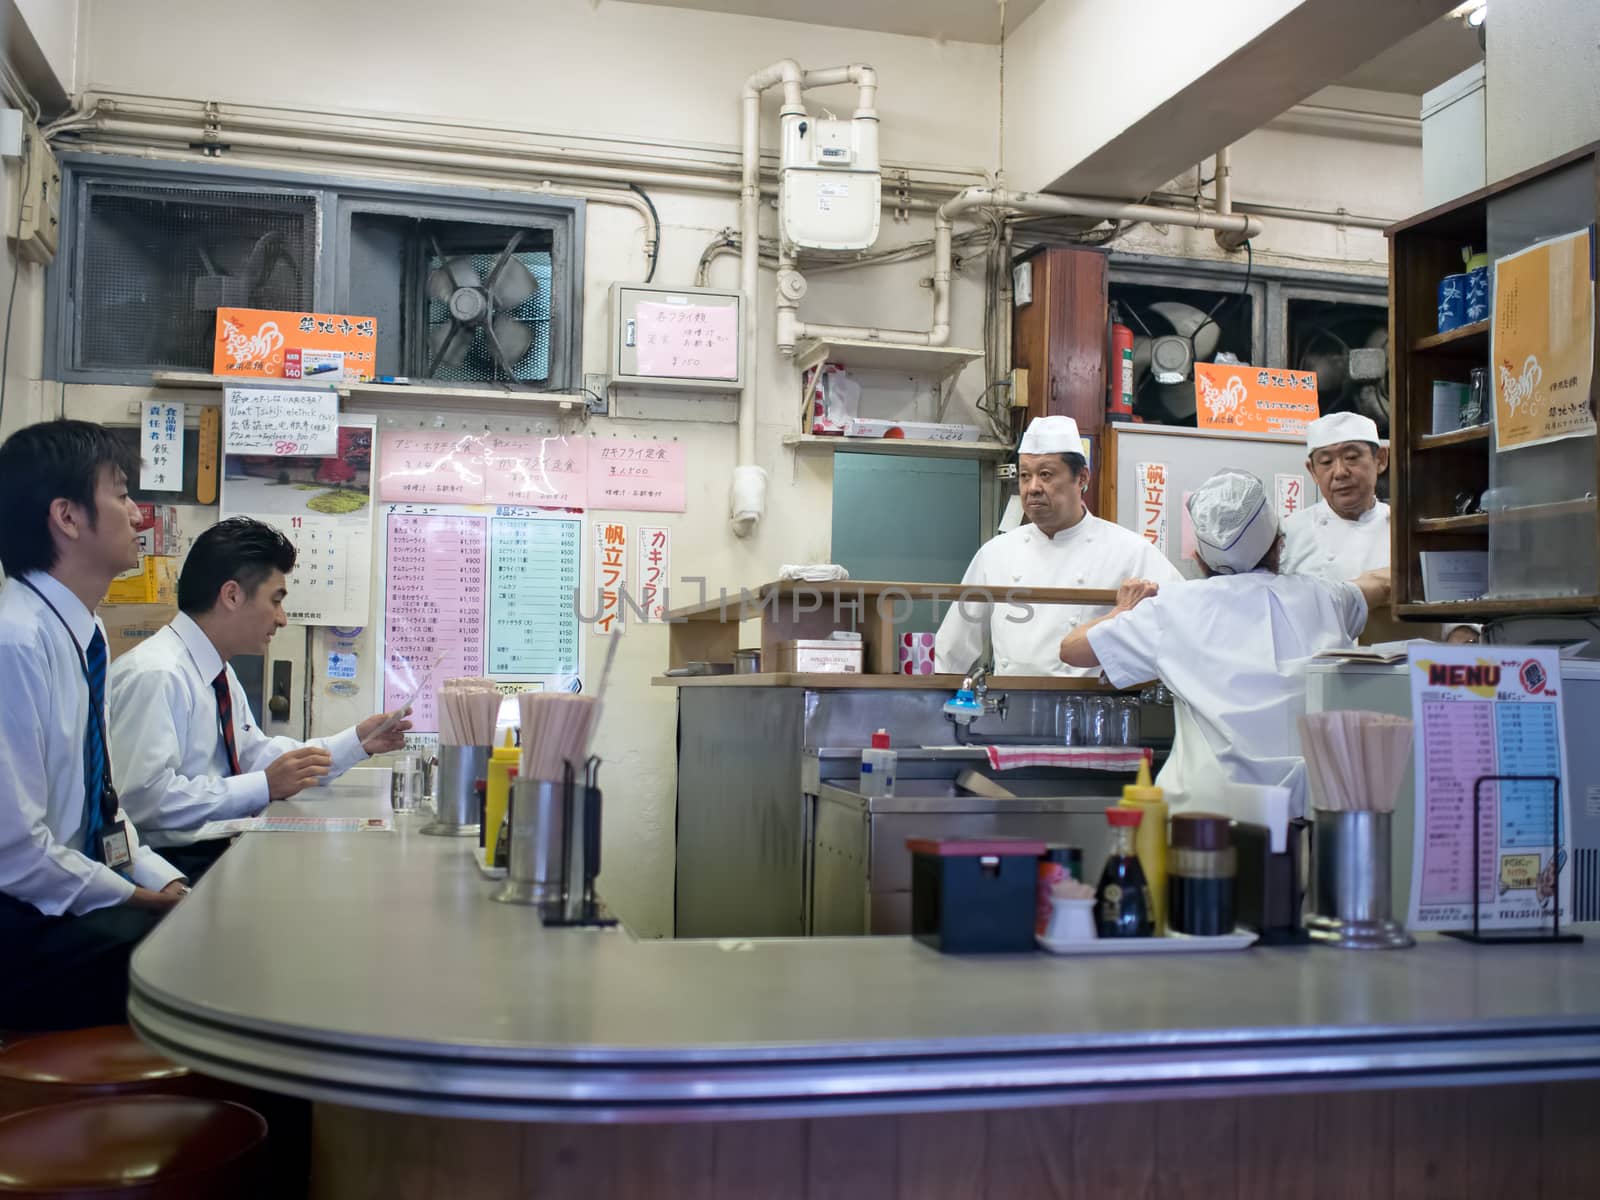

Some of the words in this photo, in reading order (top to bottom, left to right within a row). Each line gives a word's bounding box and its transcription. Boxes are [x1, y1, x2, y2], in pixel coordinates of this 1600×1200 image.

[299, 316, 374, 336] 築地市場
[1257, 370, 1315, 390] 築地市場
[149, 407, 161, 441] 責任者
[164, 407, 177, 441] 食品衛生
[601, 448, 667, 460] カキフライ定食
[390, 504, 438, 514] メニュー
[1285, 480, 1300, 517] カキ
[292, 517, 302, 528] 11
[598, 524, 625, 632] 帆立フライ
[640, 531, 666, 617] カキフライ
[1428, 664, 1500, 687] MENU
